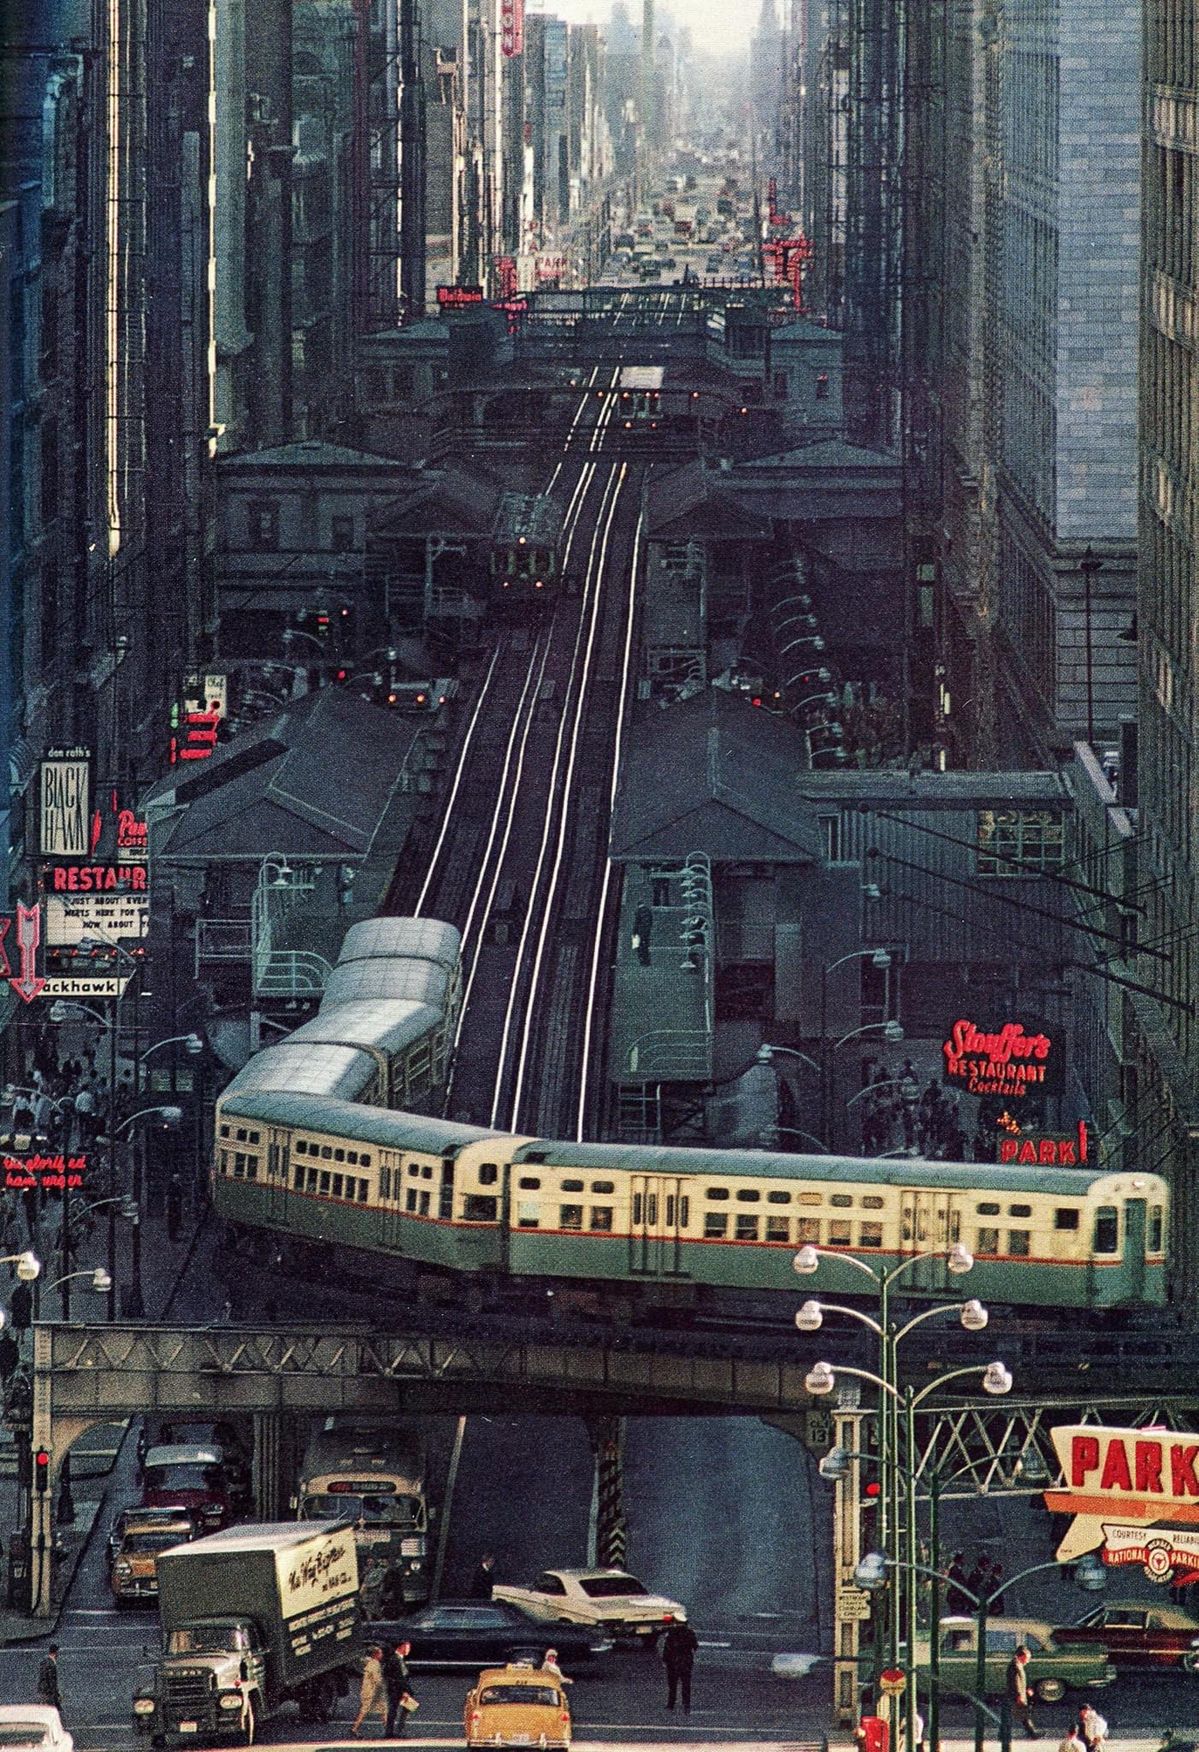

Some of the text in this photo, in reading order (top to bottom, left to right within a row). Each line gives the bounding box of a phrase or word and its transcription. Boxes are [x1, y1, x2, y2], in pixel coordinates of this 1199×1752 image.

[48, 746, 64, 758] don
[45, 767, 87, 808] BLACK
[45, 809, 85, 851] HAWK
[70, 897, 90, 905] JUST
[94, 897, 120, 905] ABOUT
[64, 909, 90, 917] MEETS
[95, 909, 115, 917] HERE
[120, 909, 135, 917] FOR
[82, 921, 100, 929] HOW
[107, 921, 134, 929] ABOUT
[944, 1019, 1051, 1062] Stouffer's
[948, 1059, 1046, 1083] RESTAURANT
[969, 1077, 1026, 1097] Cocktails
[1001, 1140, 1076, 1165] PARK
[1071, 1436, 1199, 1497] PARK
[1112, 1529, 1147, 1541] COURTESY
[1108, 1549, 1147, 1564] NATIONAL
